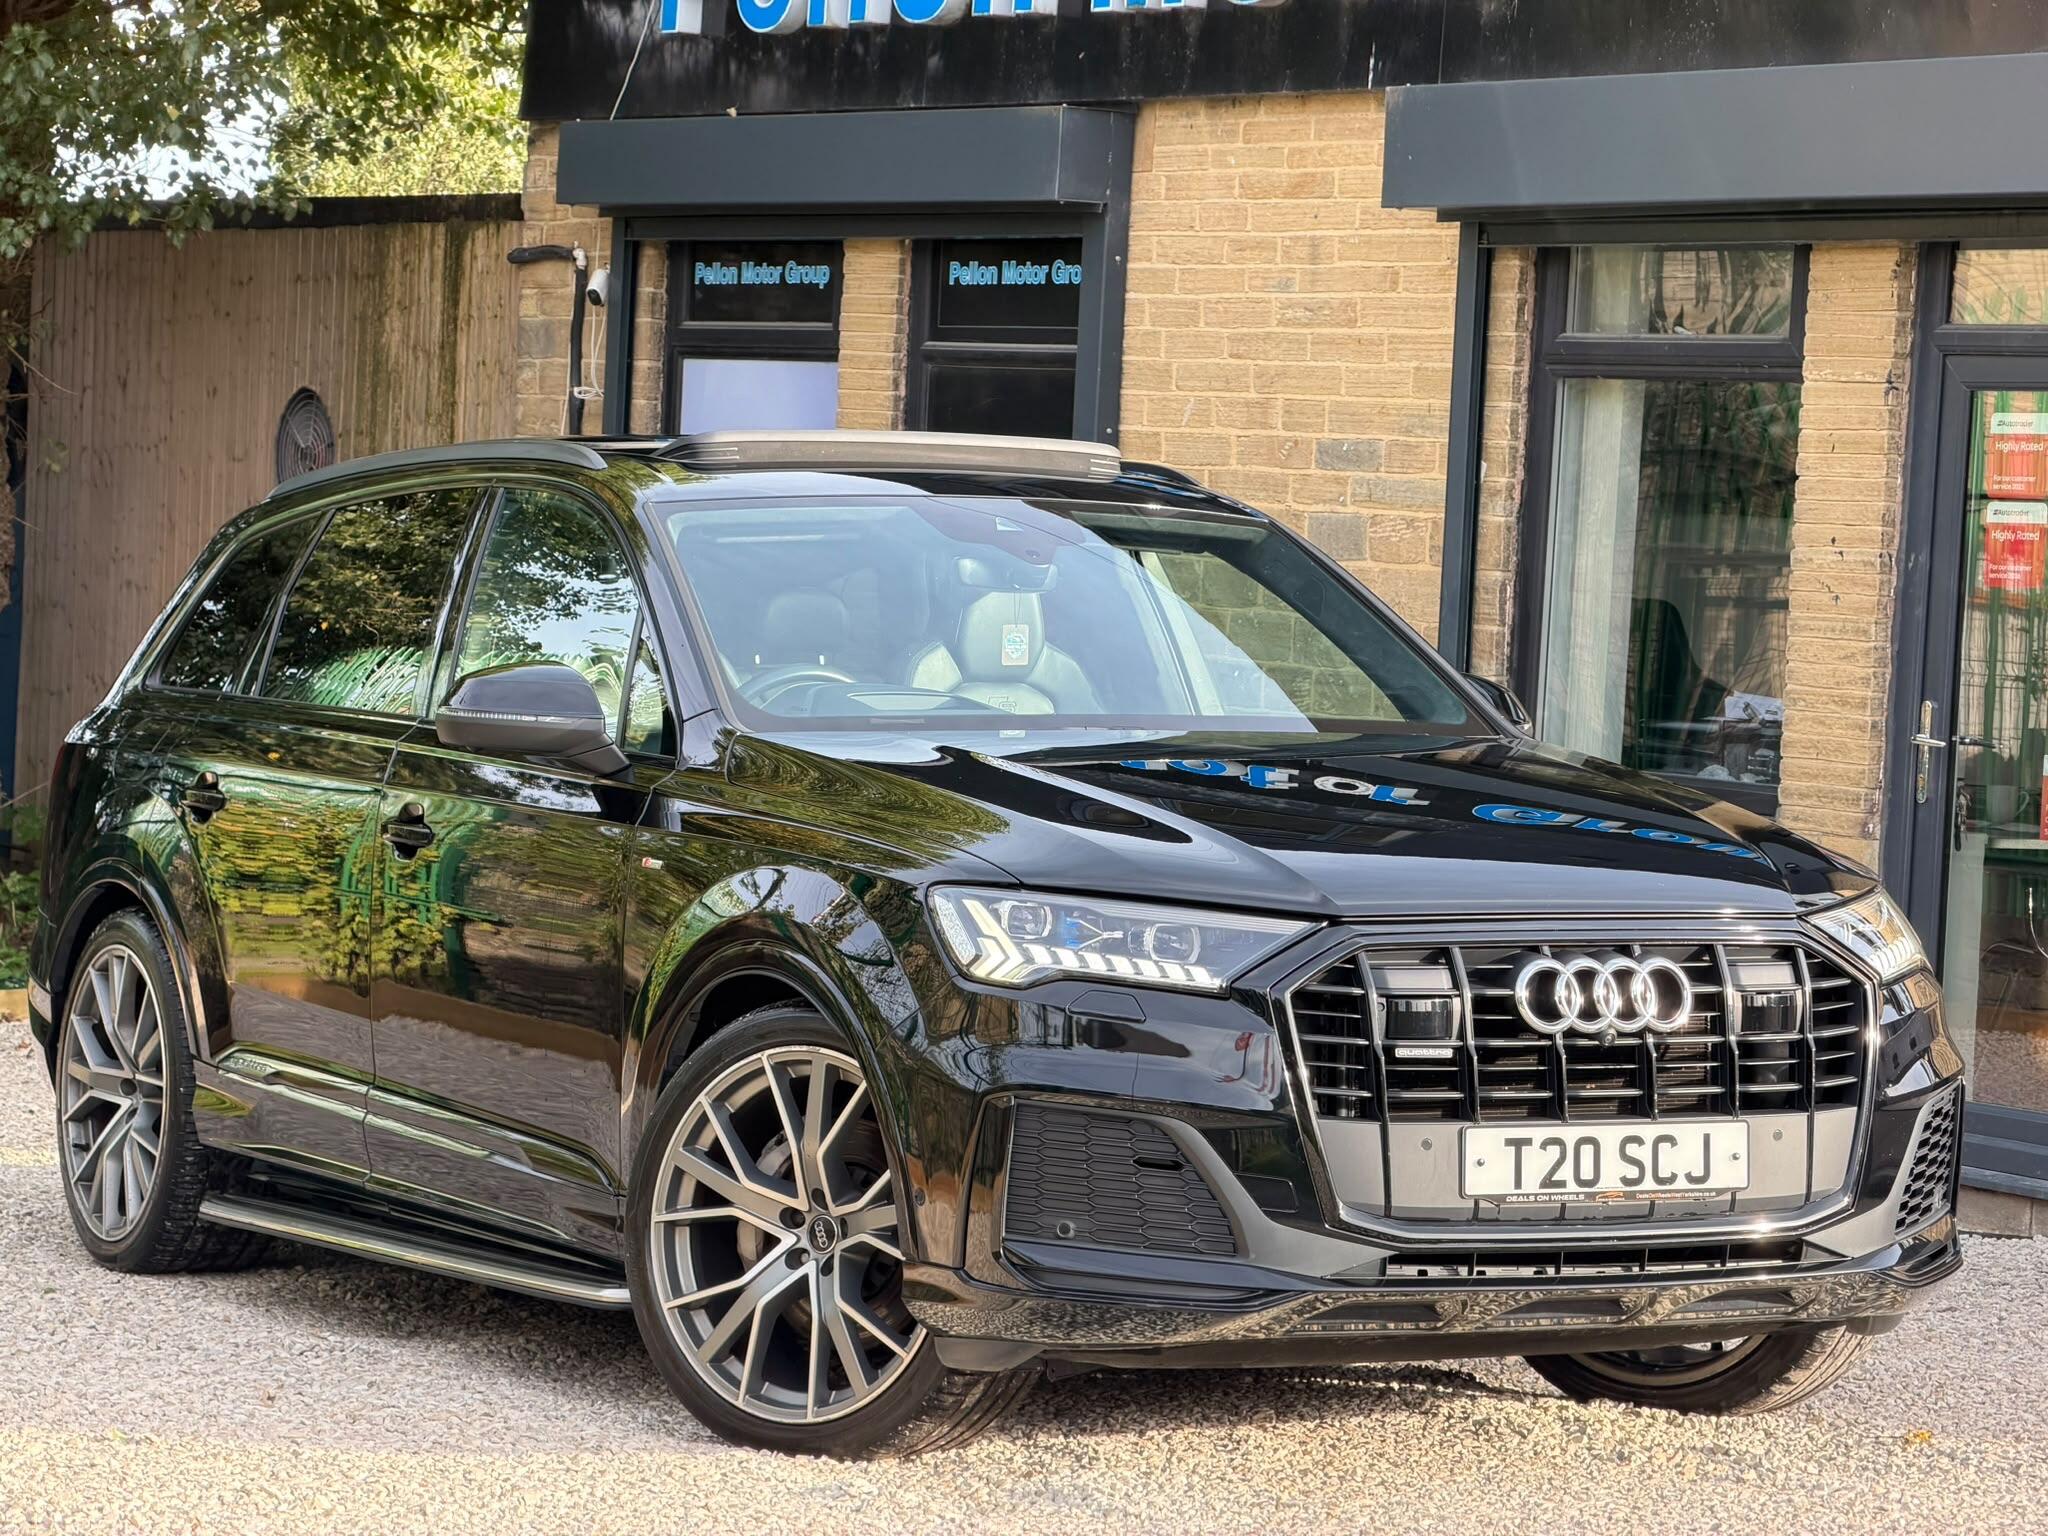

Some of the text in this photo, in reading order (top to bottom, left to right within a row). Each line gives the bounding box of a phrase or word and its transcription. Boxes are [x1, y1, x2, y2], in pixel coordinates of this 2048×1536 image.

[694, 260, 830, 288] Pellon Motor Group
[948, 261, 998, 285] Pellon
[1001, 261, 1048, 285] Motor
[1995, 440, 2044, 453] Highly Rated
[1991, 529, 2040, 542] Highly Rated
[1397, 1048, 1452, 1058] quattro
[1503, 1132, 1713, 1191] T20 SCJ
[1505, 1195, 1536, 1203] DEALS
